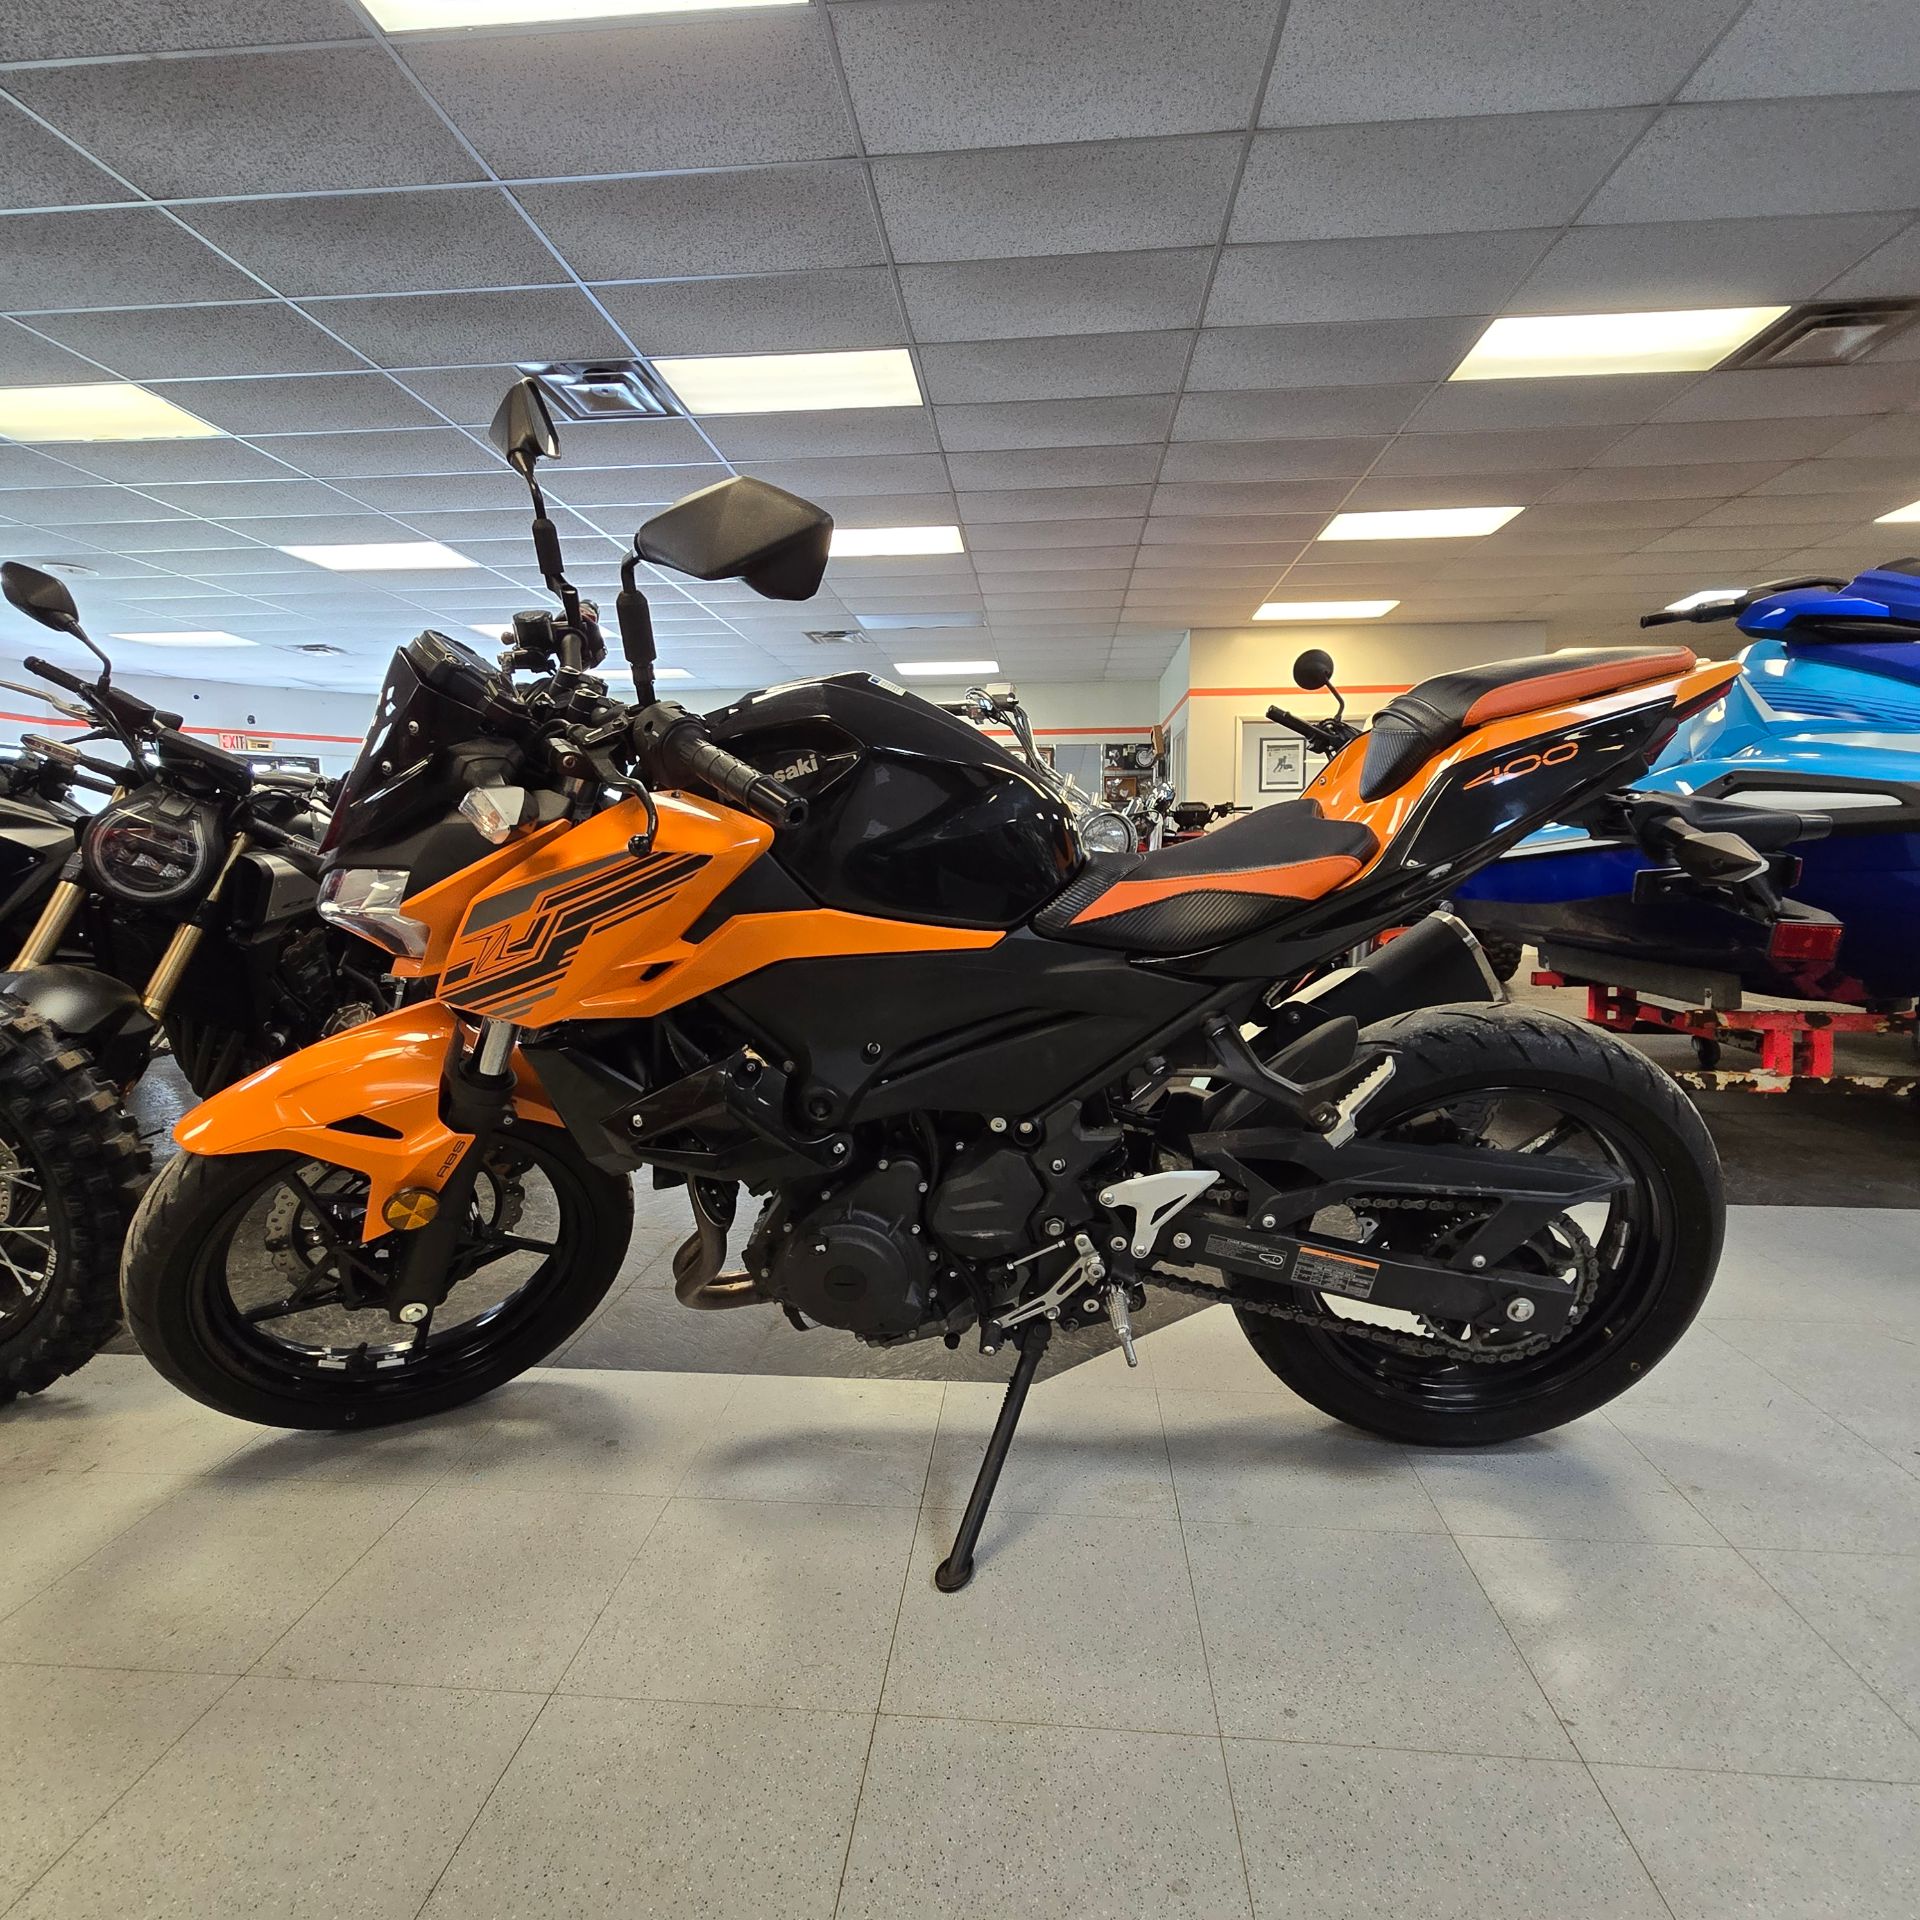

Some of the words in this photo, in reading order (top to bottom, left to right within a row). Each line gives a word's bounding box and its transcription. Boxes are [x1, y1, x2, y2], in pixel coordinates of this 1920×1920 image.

[222, 735, 245, 749] EXIT
[773, 753, 819, 783] saki
[1463, 742, 1579, 790] 400
[436, 1140, 466, 1178] ABS
